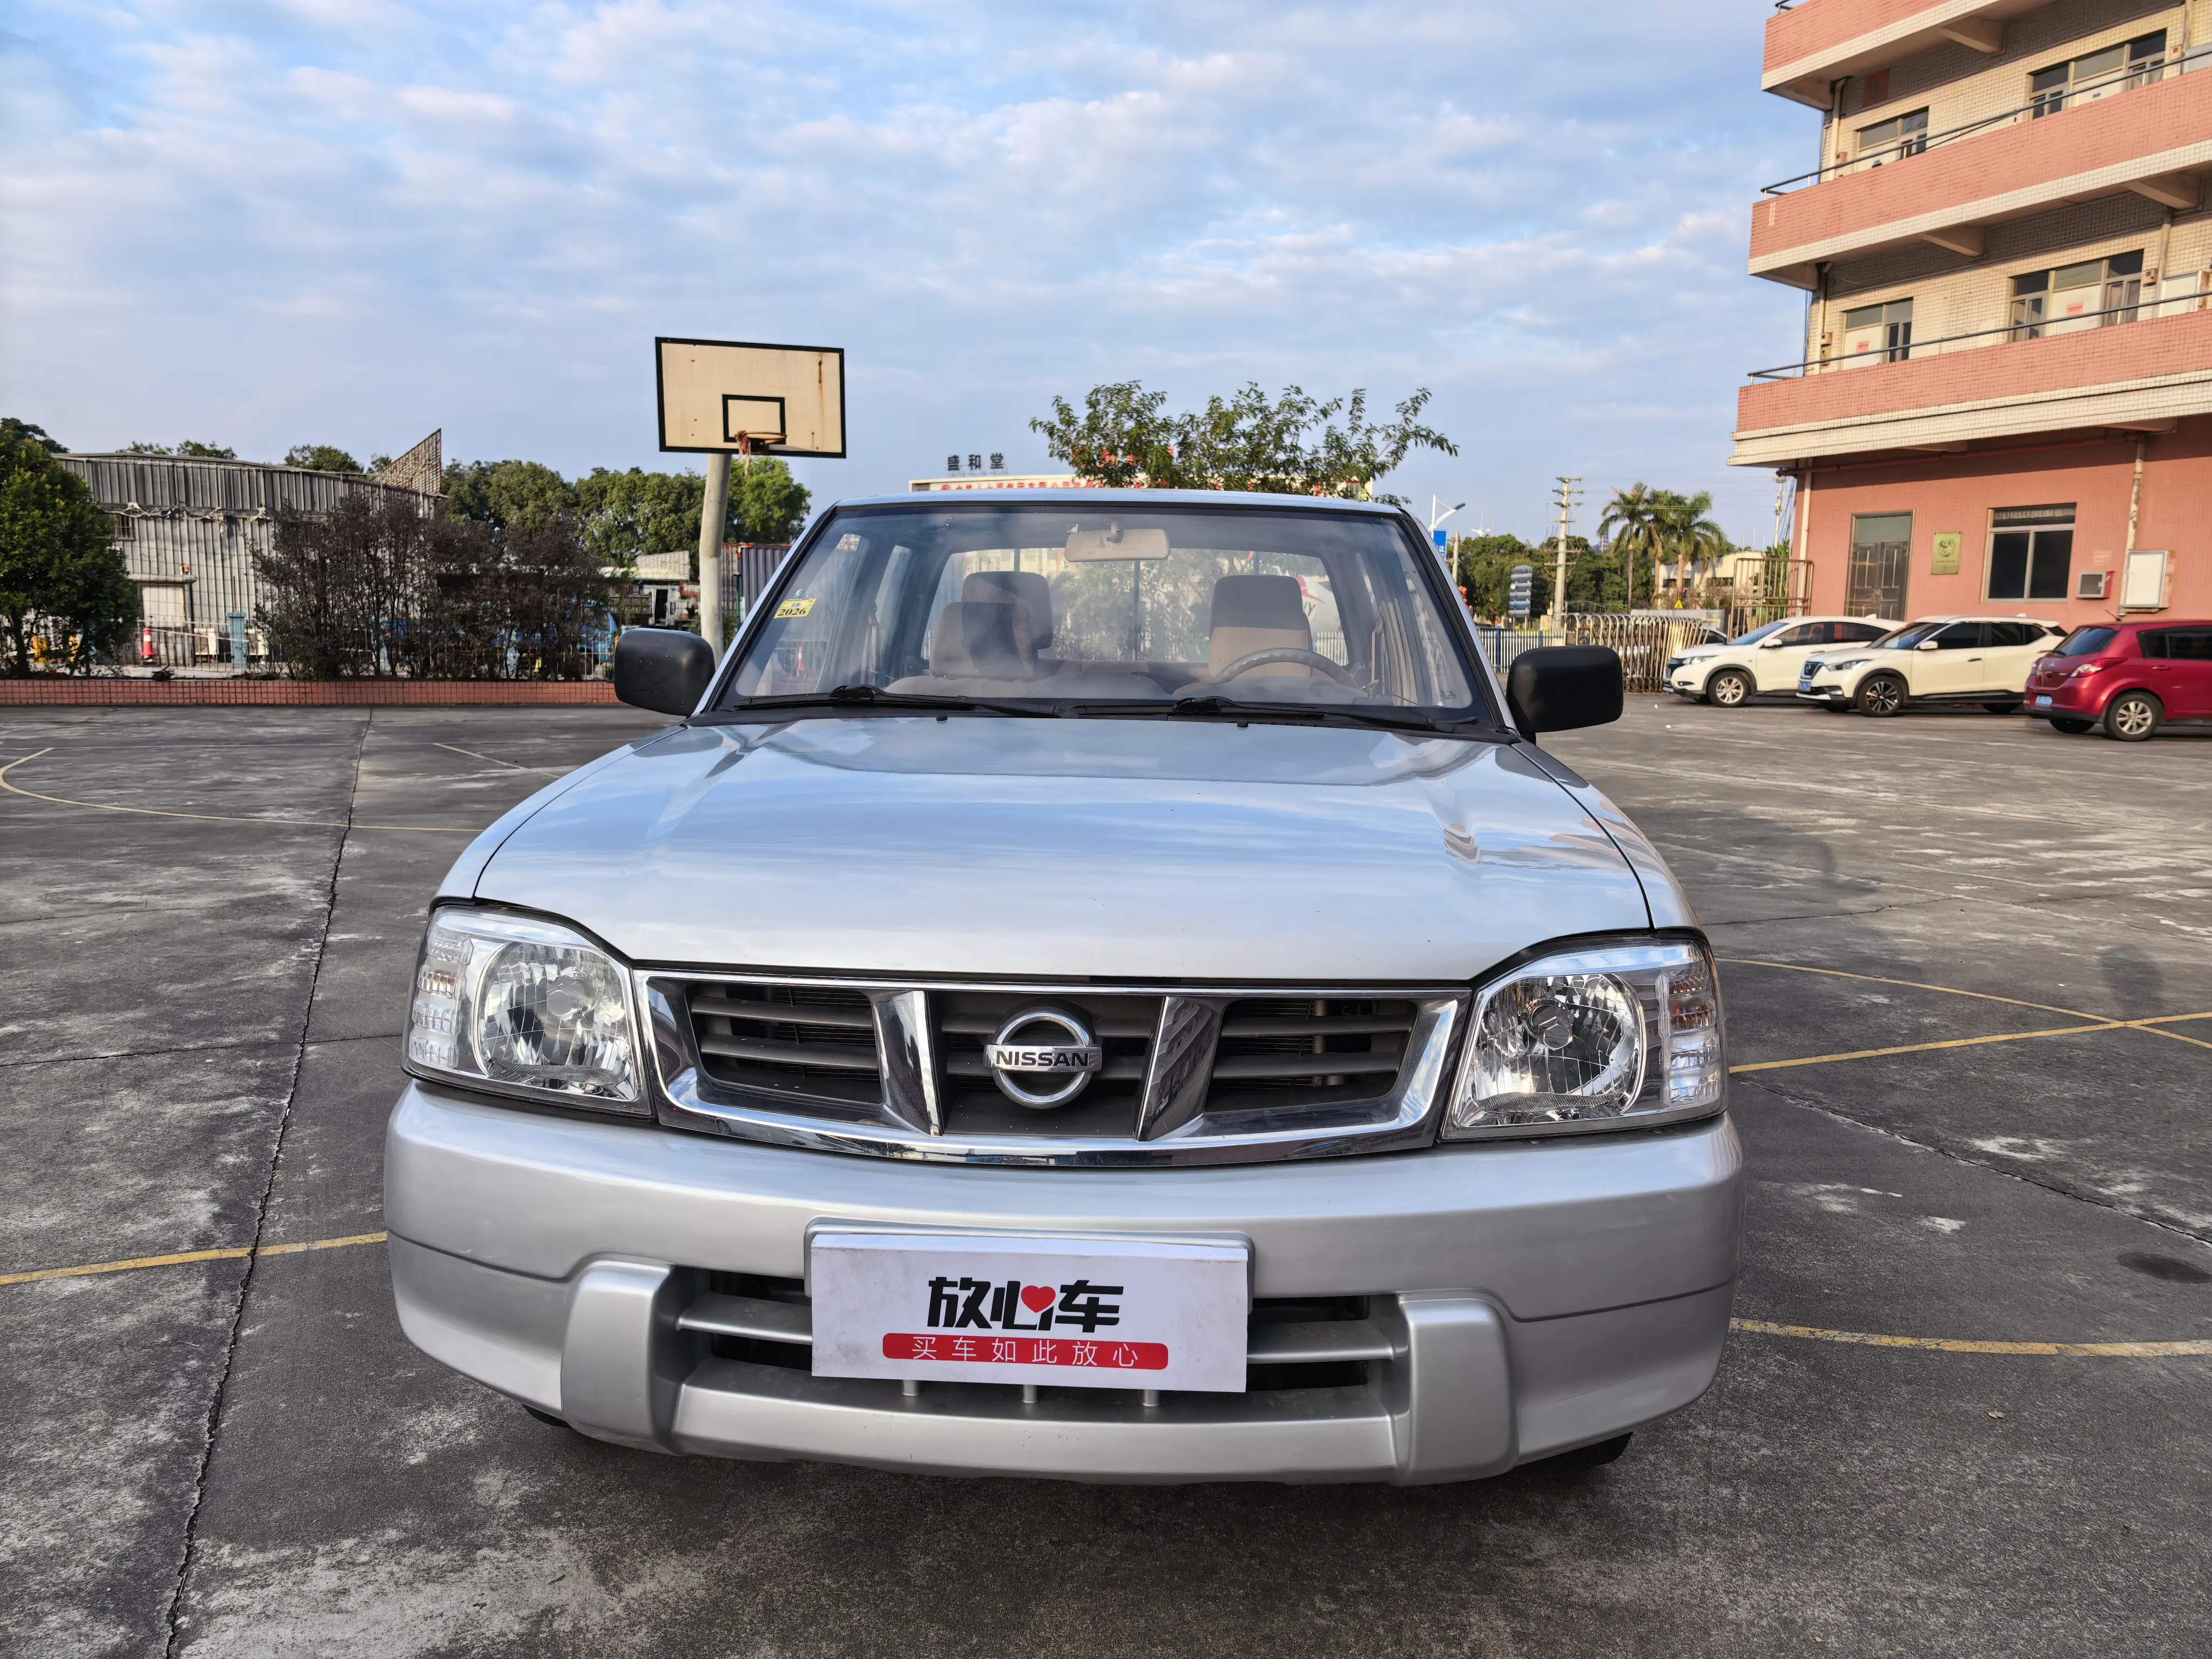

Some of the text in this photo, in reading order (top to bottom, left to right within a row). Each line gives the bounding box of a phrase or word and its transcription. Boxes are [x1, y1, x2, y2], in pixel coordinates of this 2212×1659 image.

[948, 453, 1003, 471] 盛和堂
[778, 608, 808, 616] 2026
[996, 1051, 1089, 1067] NISSAN
[927, 1277, 1124, 1333] 放心车
[912, 1336, 1138, 1367] 买车如此放心
